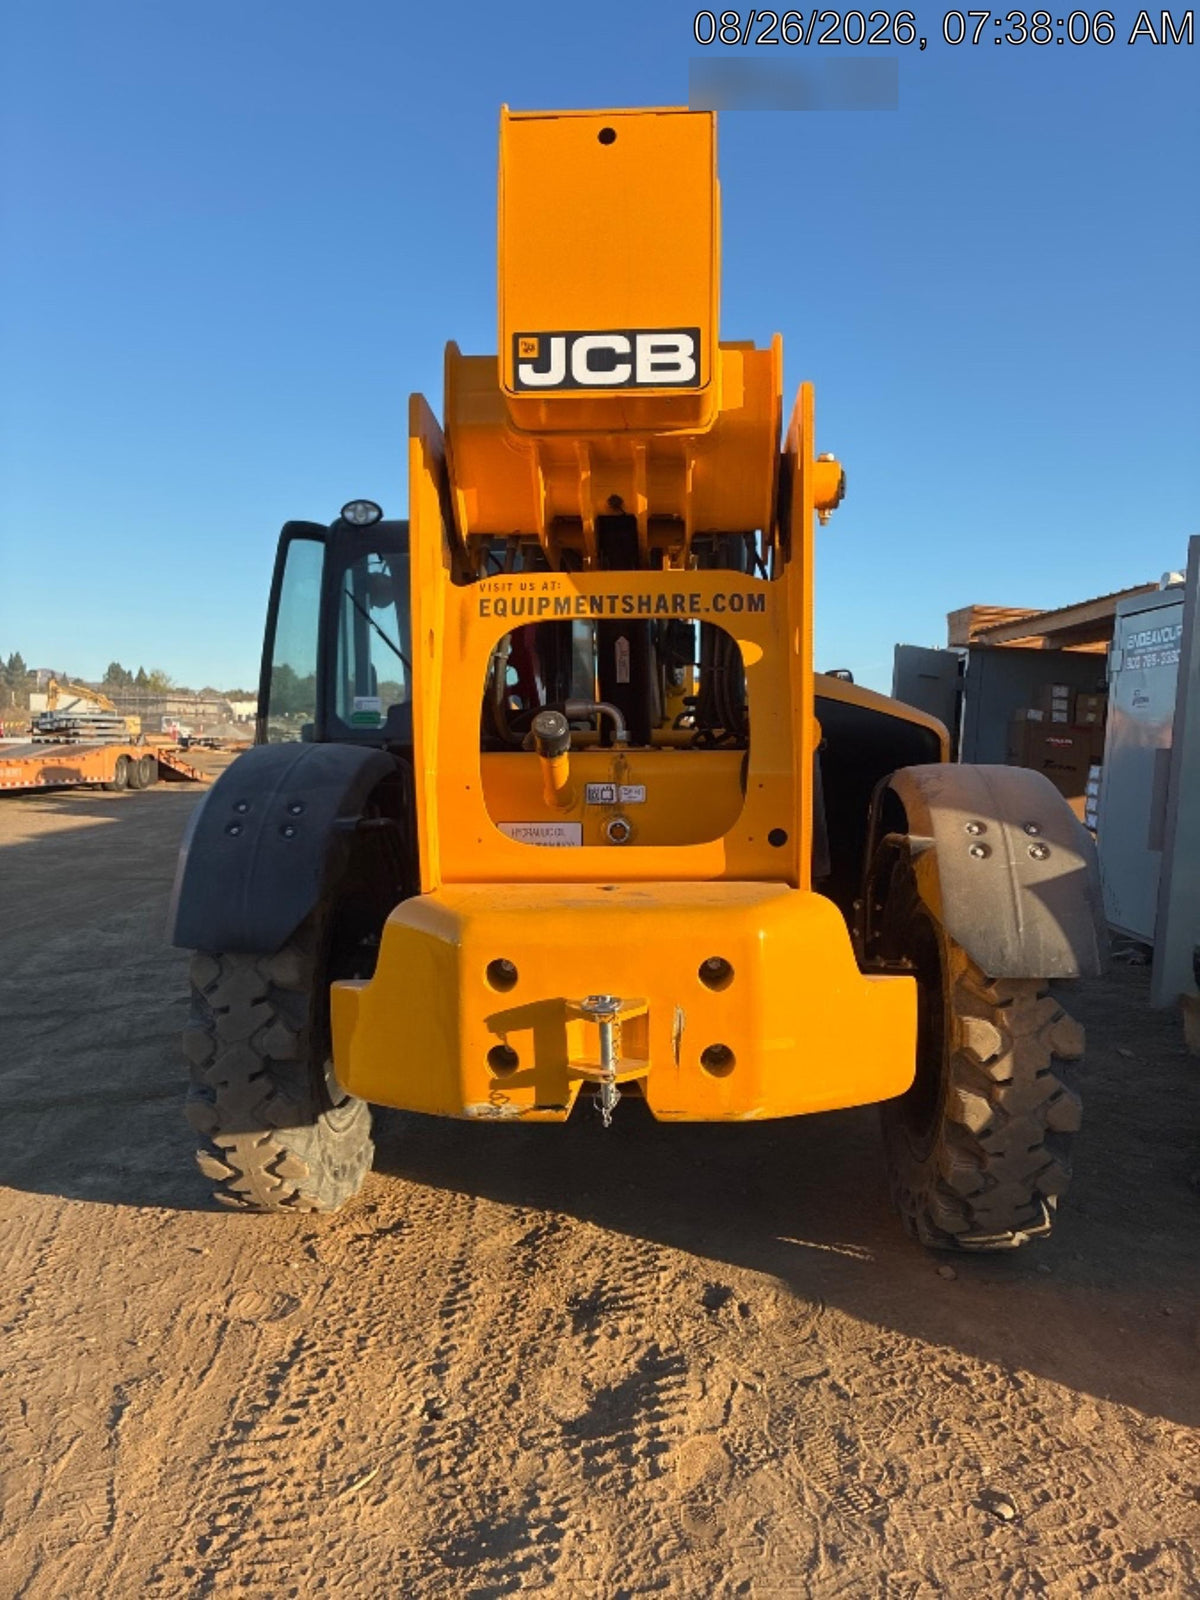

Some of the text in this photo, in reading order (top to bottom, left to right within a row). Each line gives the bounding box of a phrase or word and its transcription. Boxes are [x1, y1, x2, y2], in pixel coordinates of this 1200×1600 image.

[518, 334, 696, 386] JCB
[479, 580, 561, 593] VISIT US AT:
[479, 593, 766, 618] EQUIPMENTSHARE.COM
